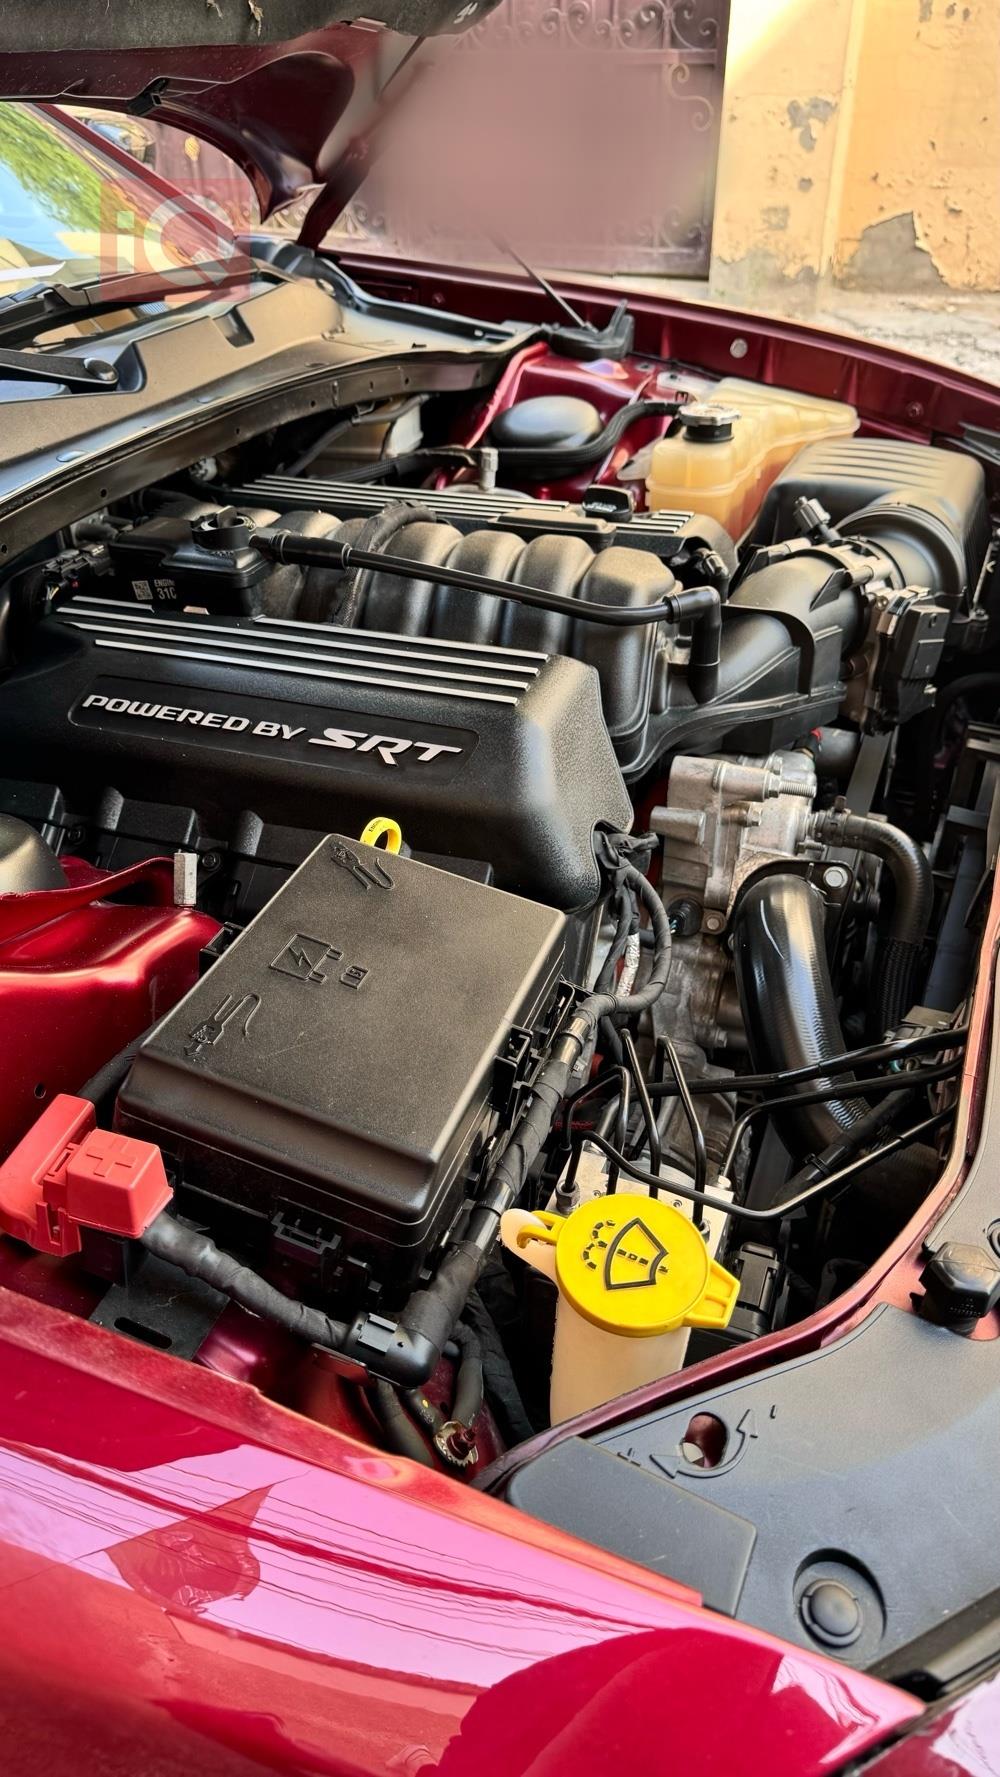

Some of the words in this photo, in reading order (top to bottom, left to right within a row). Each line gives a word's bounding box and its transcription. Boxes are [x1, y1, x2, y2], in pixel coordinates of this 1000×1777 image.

[156, 586, 177, 601] 31C
[82, 694, 250, 731] POWERED
[252, 720, 306, 740] BY
[308, 727, 463, 765] SRT
